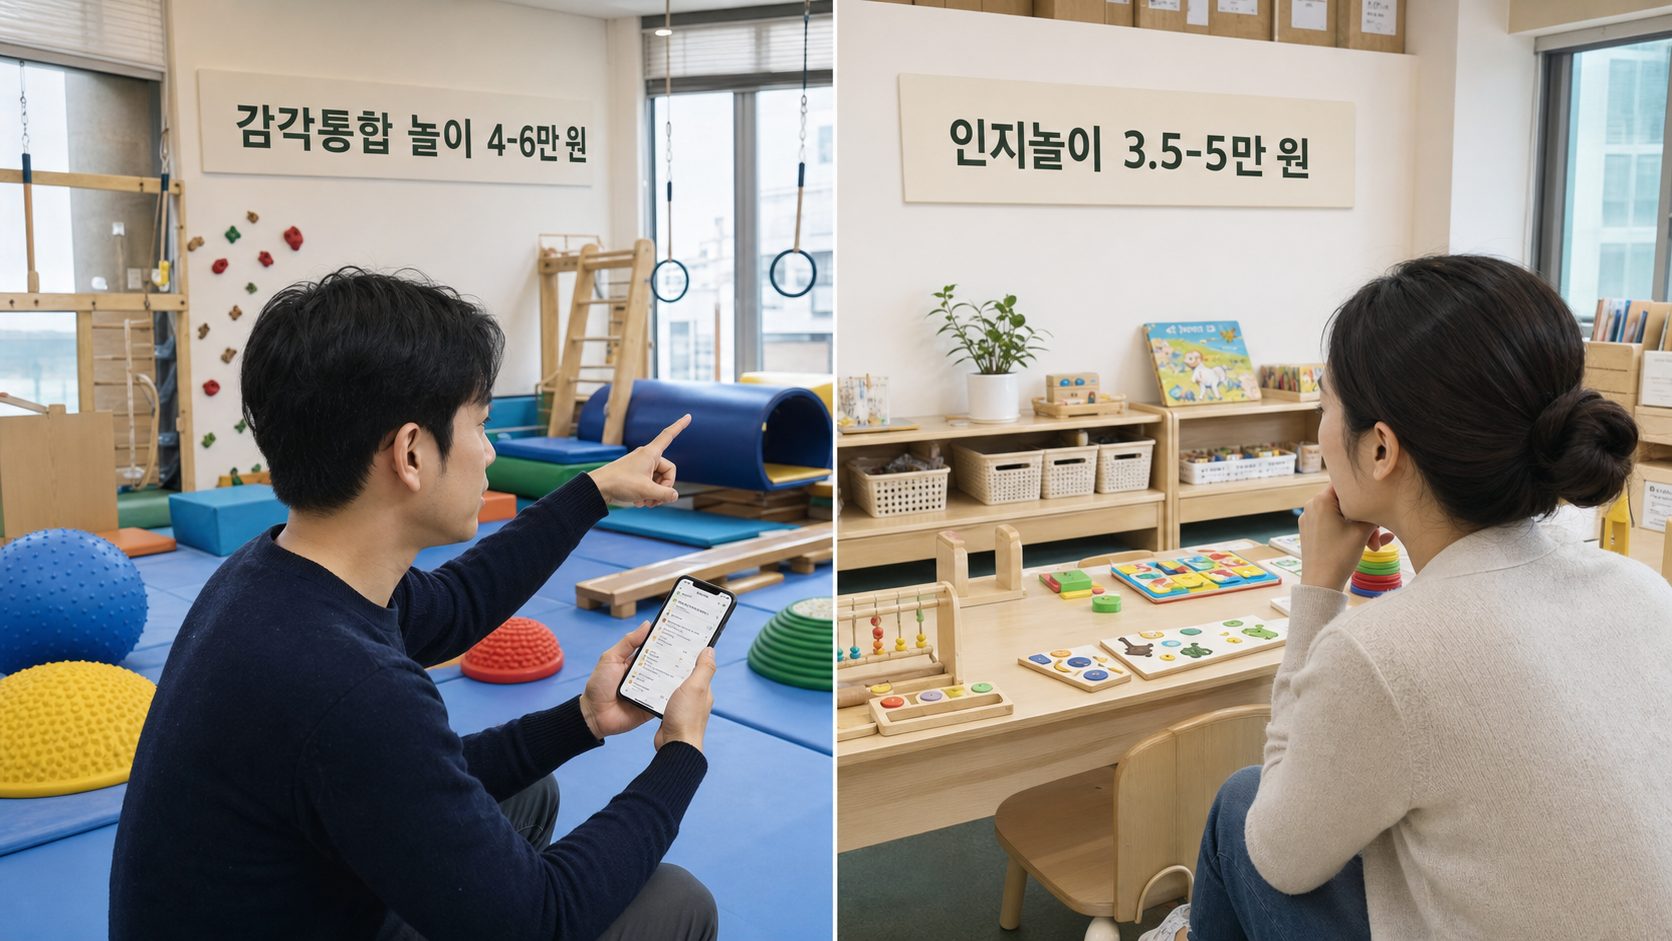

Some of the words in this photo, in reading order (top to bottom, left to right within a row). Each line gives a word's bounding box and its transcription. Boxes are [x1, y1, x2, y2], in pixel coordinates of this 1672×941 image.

[236, 104, 393, 154] 감각통합
[408, 114, 471, 158] 놀이
[950, 119, 1101, 172] 인지놀이
